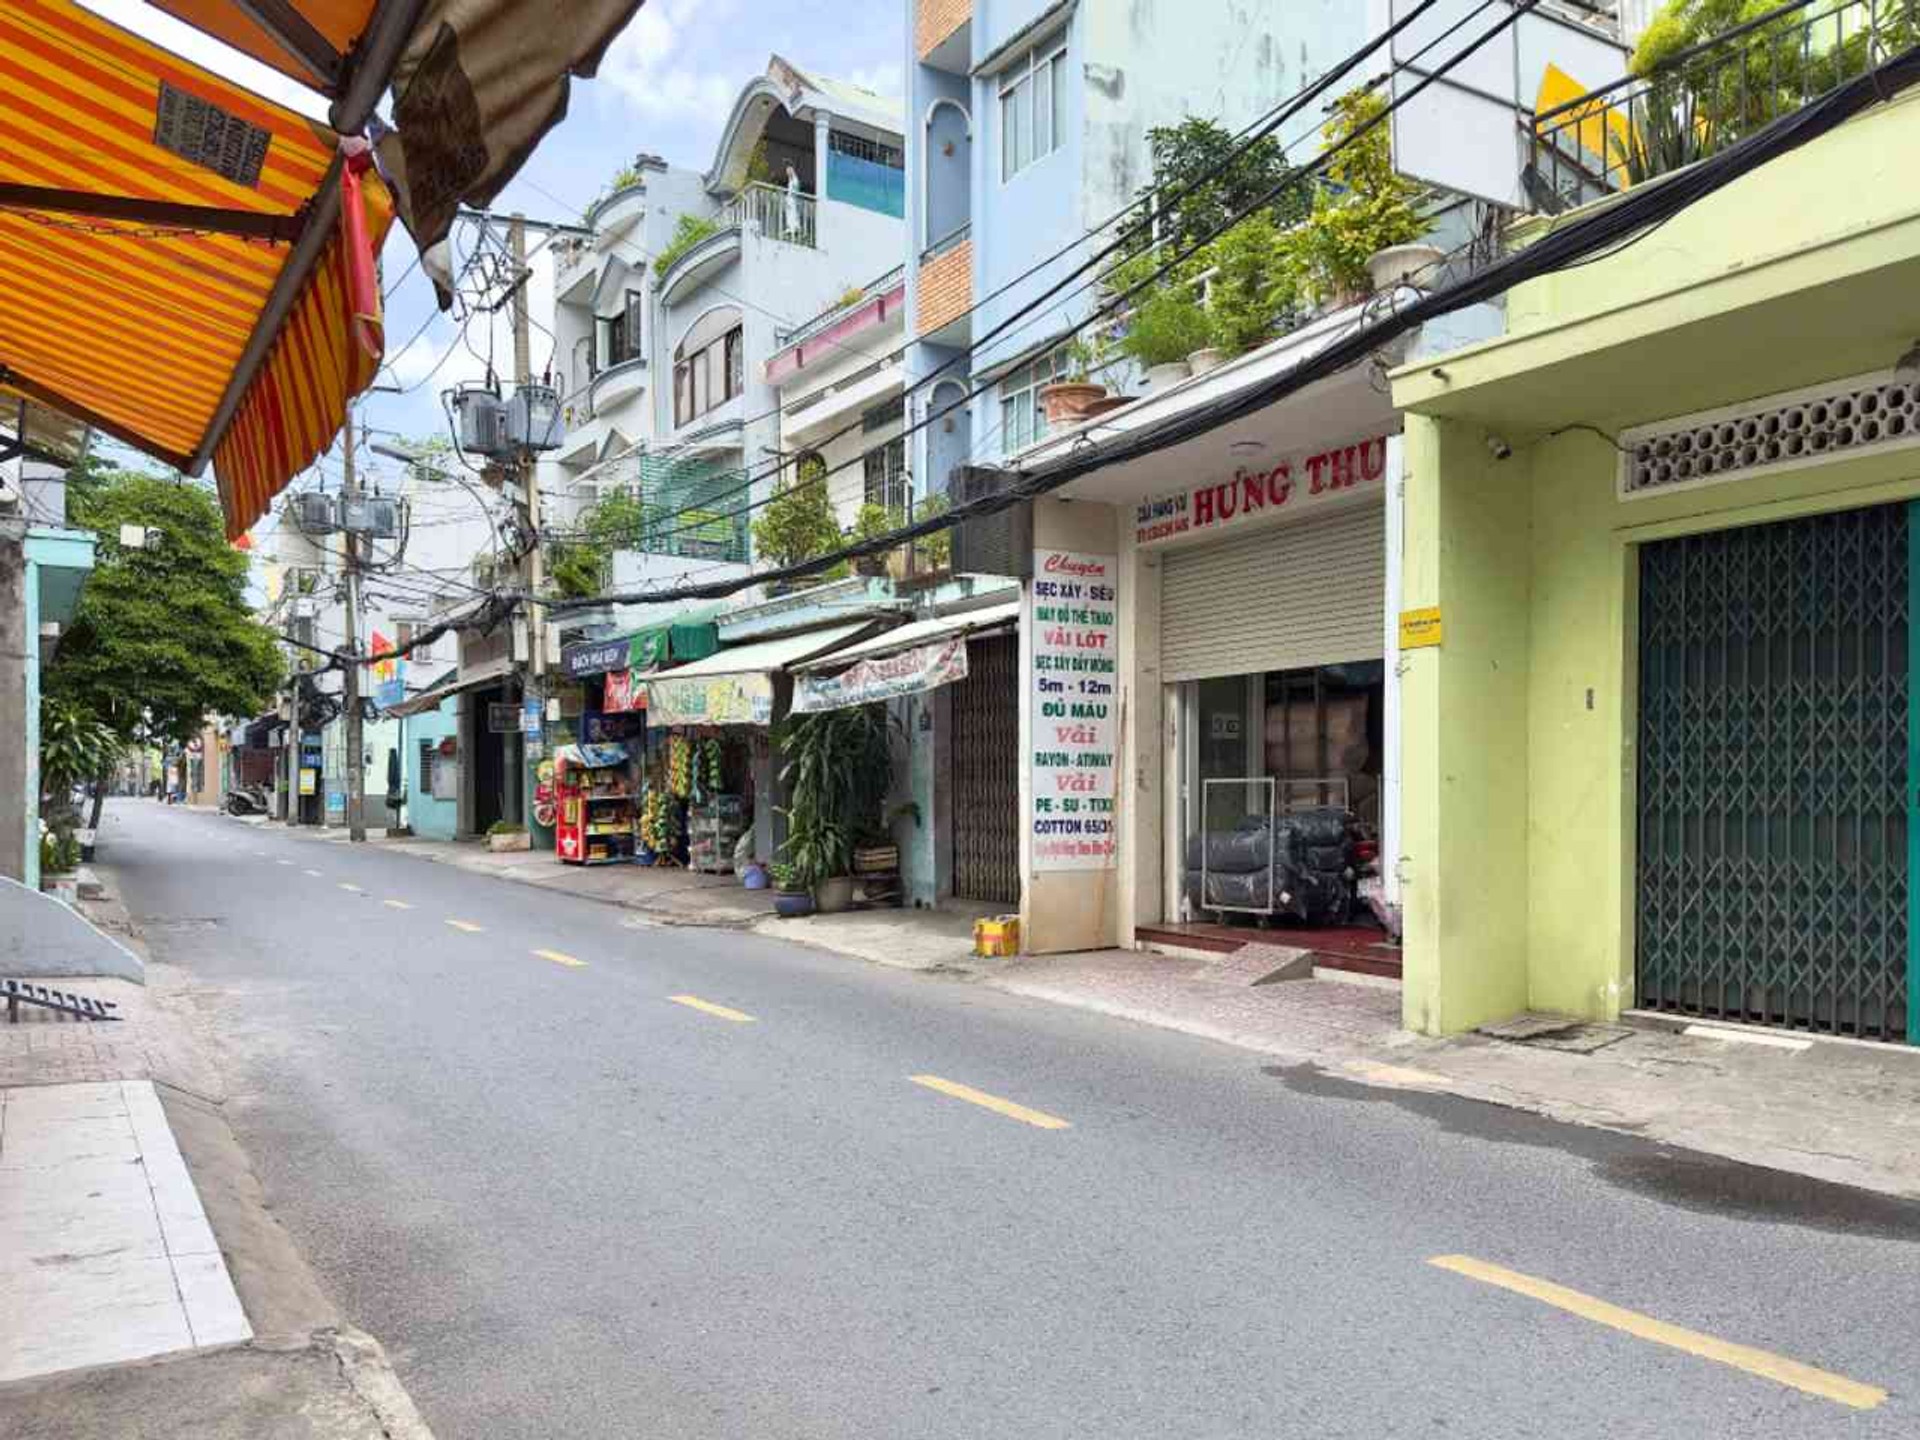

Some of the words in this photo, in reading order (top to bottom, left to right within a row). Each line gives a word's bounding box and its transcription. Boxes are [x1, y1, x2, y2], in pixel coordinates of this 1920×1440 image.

[1044, 626, 1071, 645] VẢI
[1038, 678, 1063, 693] 5m
[1079, 680, 1111, 695] 12m
[1042, 698, 1066, 717] ĐỦ
[1035, 751, 1069, 768] RAYON
[1036, 798, 1053, 812] PE
[1062, 798, 1079, 812] SU
[1034, 819, 1082, 834] COTTON
